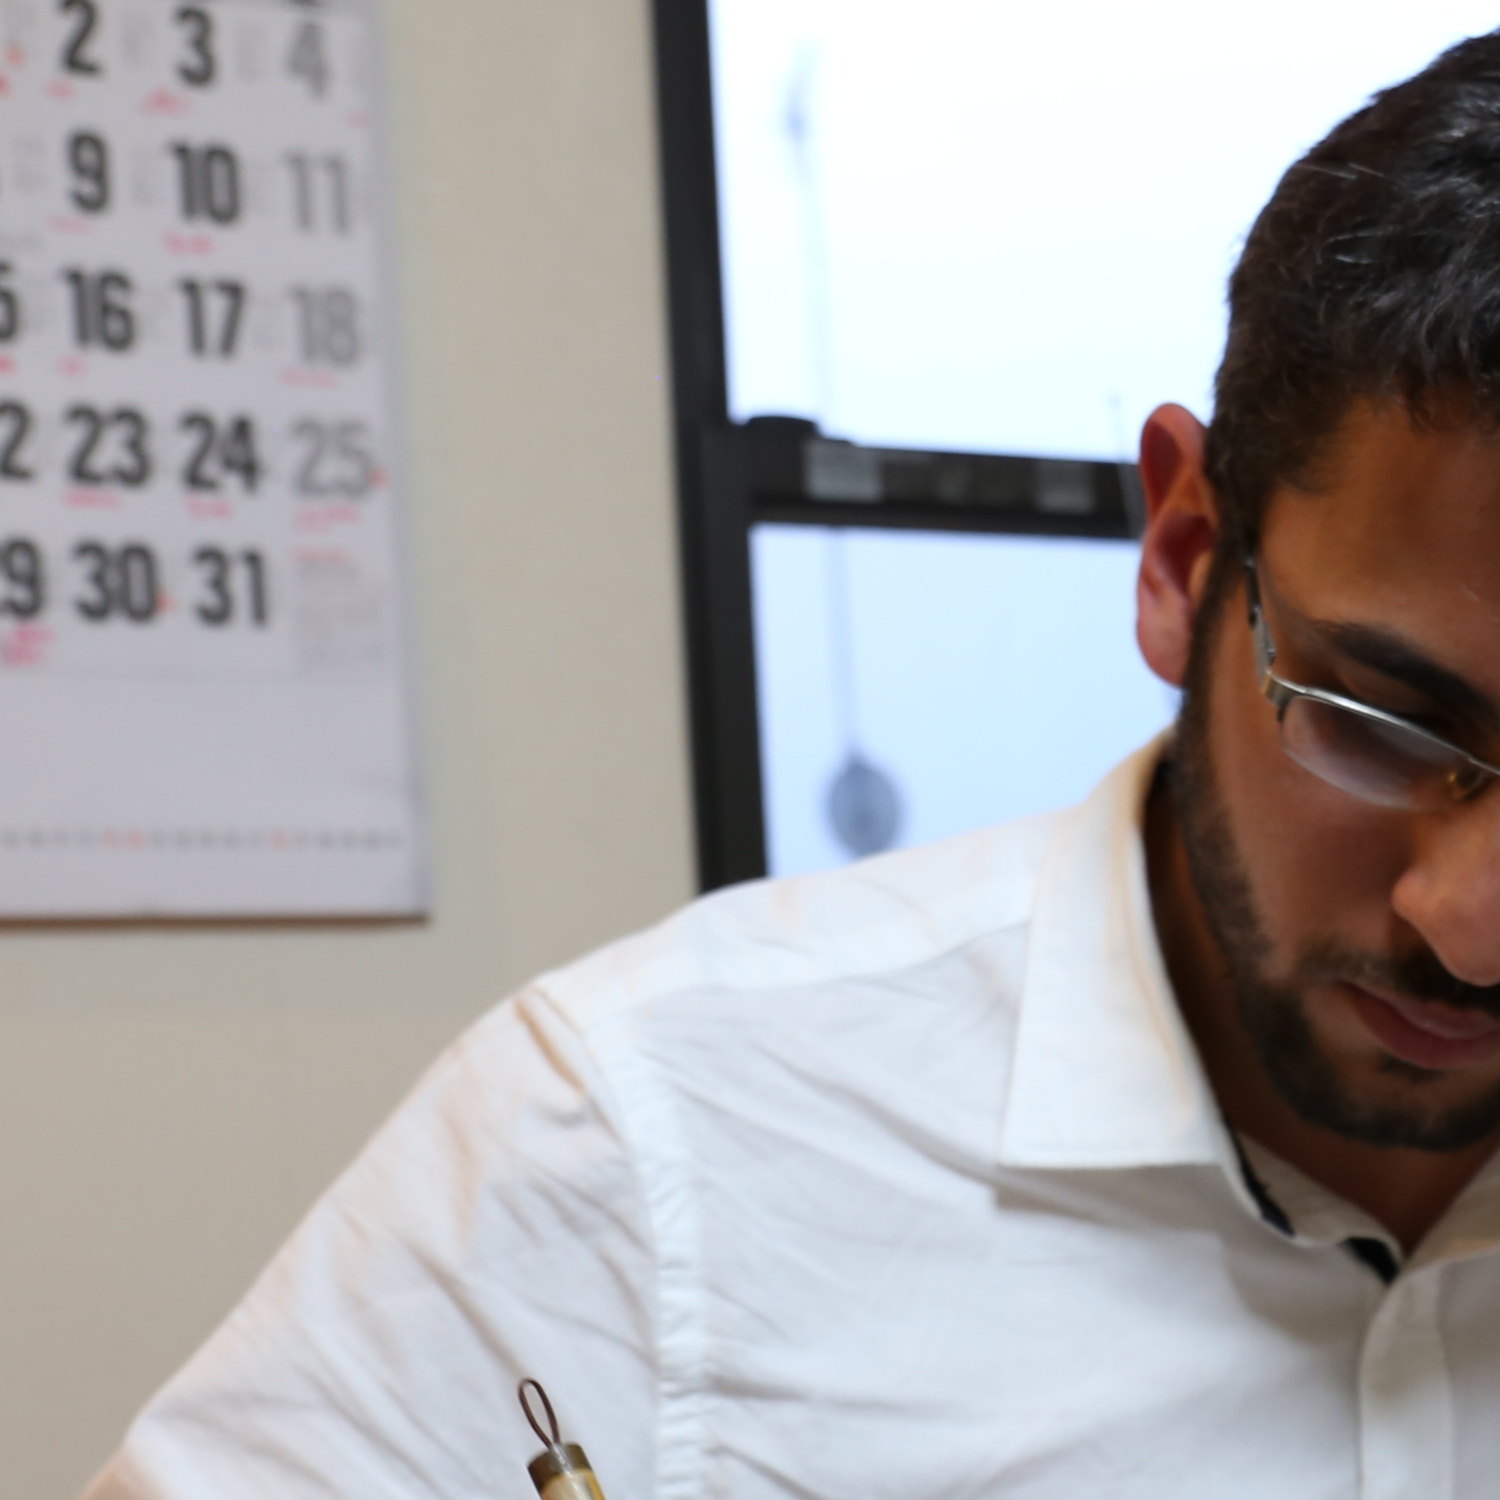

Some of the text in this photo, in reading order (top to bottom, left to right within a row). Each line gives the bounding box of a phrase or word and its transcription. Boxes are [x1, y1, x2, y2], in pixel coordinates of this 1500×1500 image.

[59, 0, 331, 102] 2 3 4
[66, 128, 351, 236] 9 10 11
[62, 265, 138, 354] 16
[176, 275, 246, 361] 17
[287, 284, 361, 369] 18
[62, 404, 153, 489] 23
[178, 413, 262, 493] 24
[291, 417, 374, 500] 25
[72, 538, 160, 625] 30
[190, 544, 269, 630] 31
